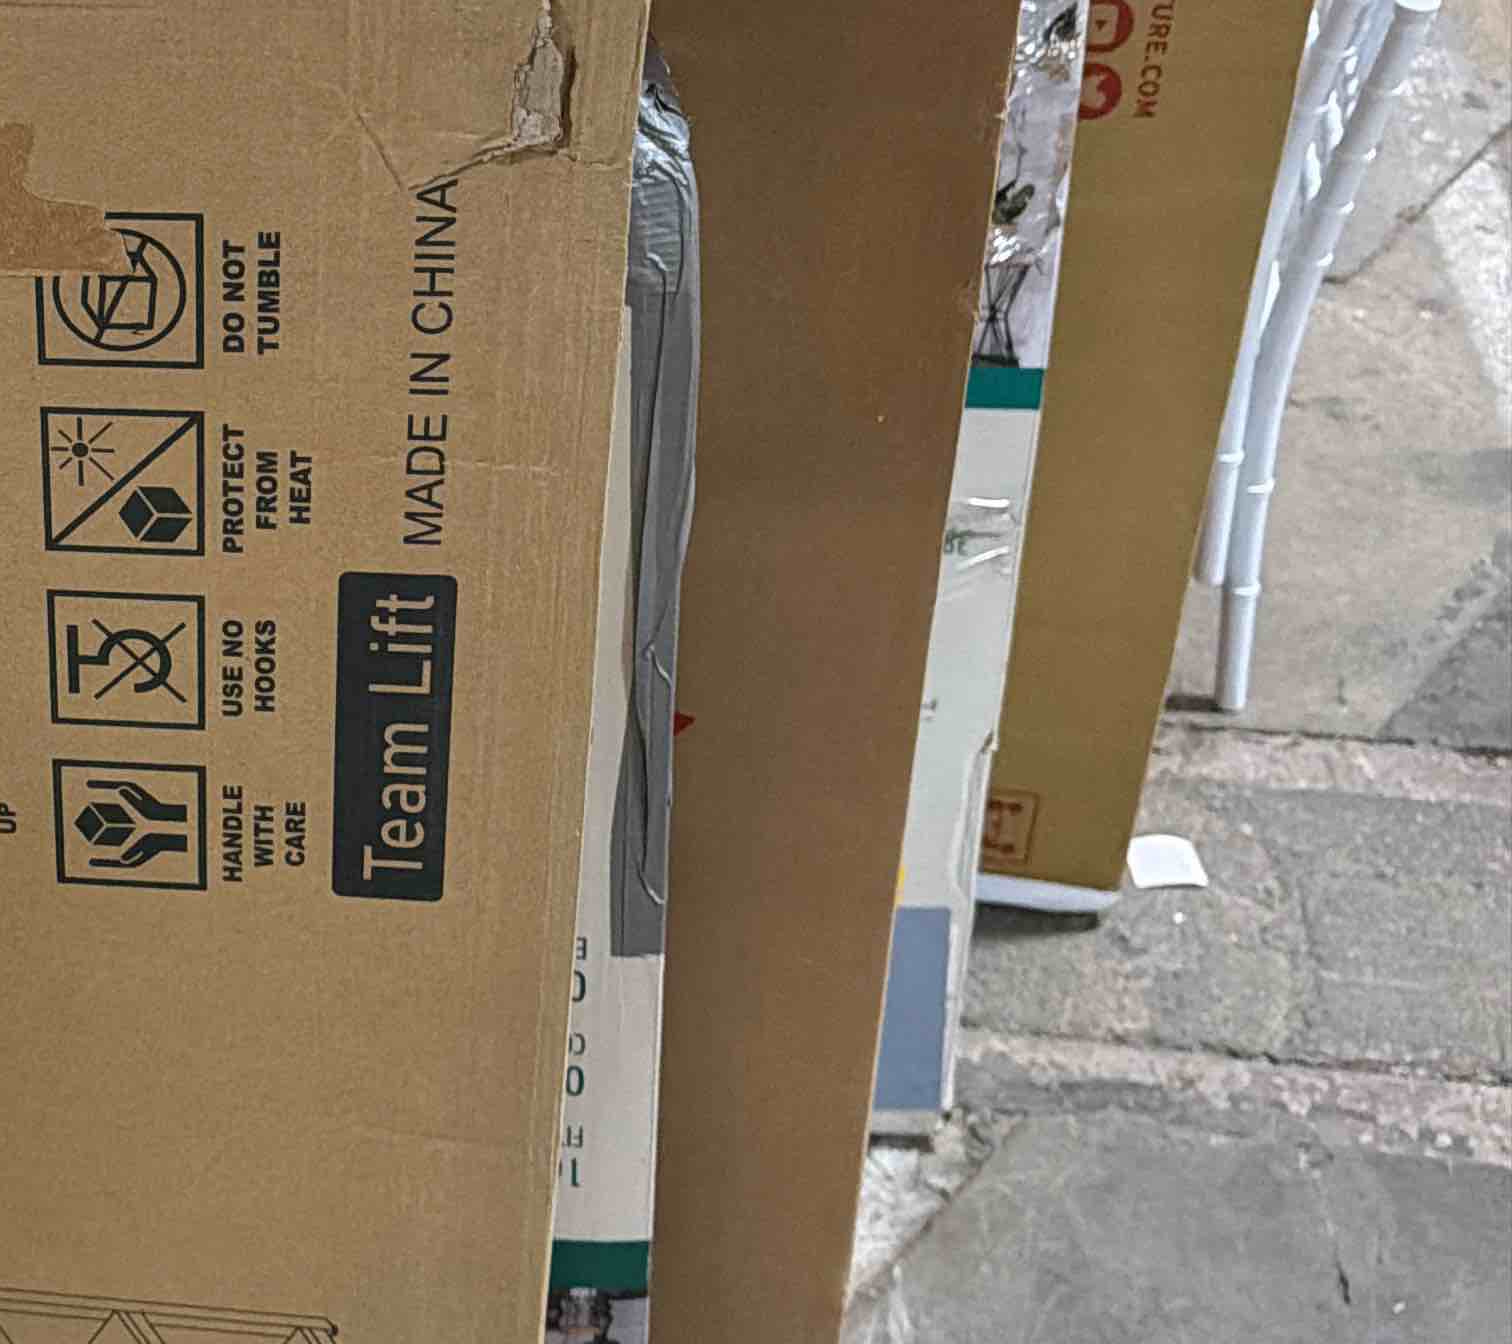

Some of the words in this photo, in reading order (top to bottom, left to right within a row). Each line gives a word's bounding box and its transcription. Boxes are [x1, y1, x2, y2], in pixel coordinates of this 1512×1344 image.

[222, 239, 245, 302] NOT
[257, 231, 281, 355] TUMBLE
[411, 178, 459, 336] CHINA
[222, 312, 245, 353] DO
[408, 352, 451, 395] IN
[222, 423, 245, 554] PROTECT
[256, 451, 279, 530] FROM
[289, 450, 312, 525] HEAT
[403, 414, 448, 546] MADE
[222, 619, 244, 657] NO
[254, 619, 276, 712] HOOKS
[367, 593, 434, 694] Lift
[222, 666, 244, 717] USE
[222, 784, 243, 882] HANDLE
[253, 804, 274, 867] WITH
[285, 801, 306, 867] CARE
[363, 723, 429, 881] Team
